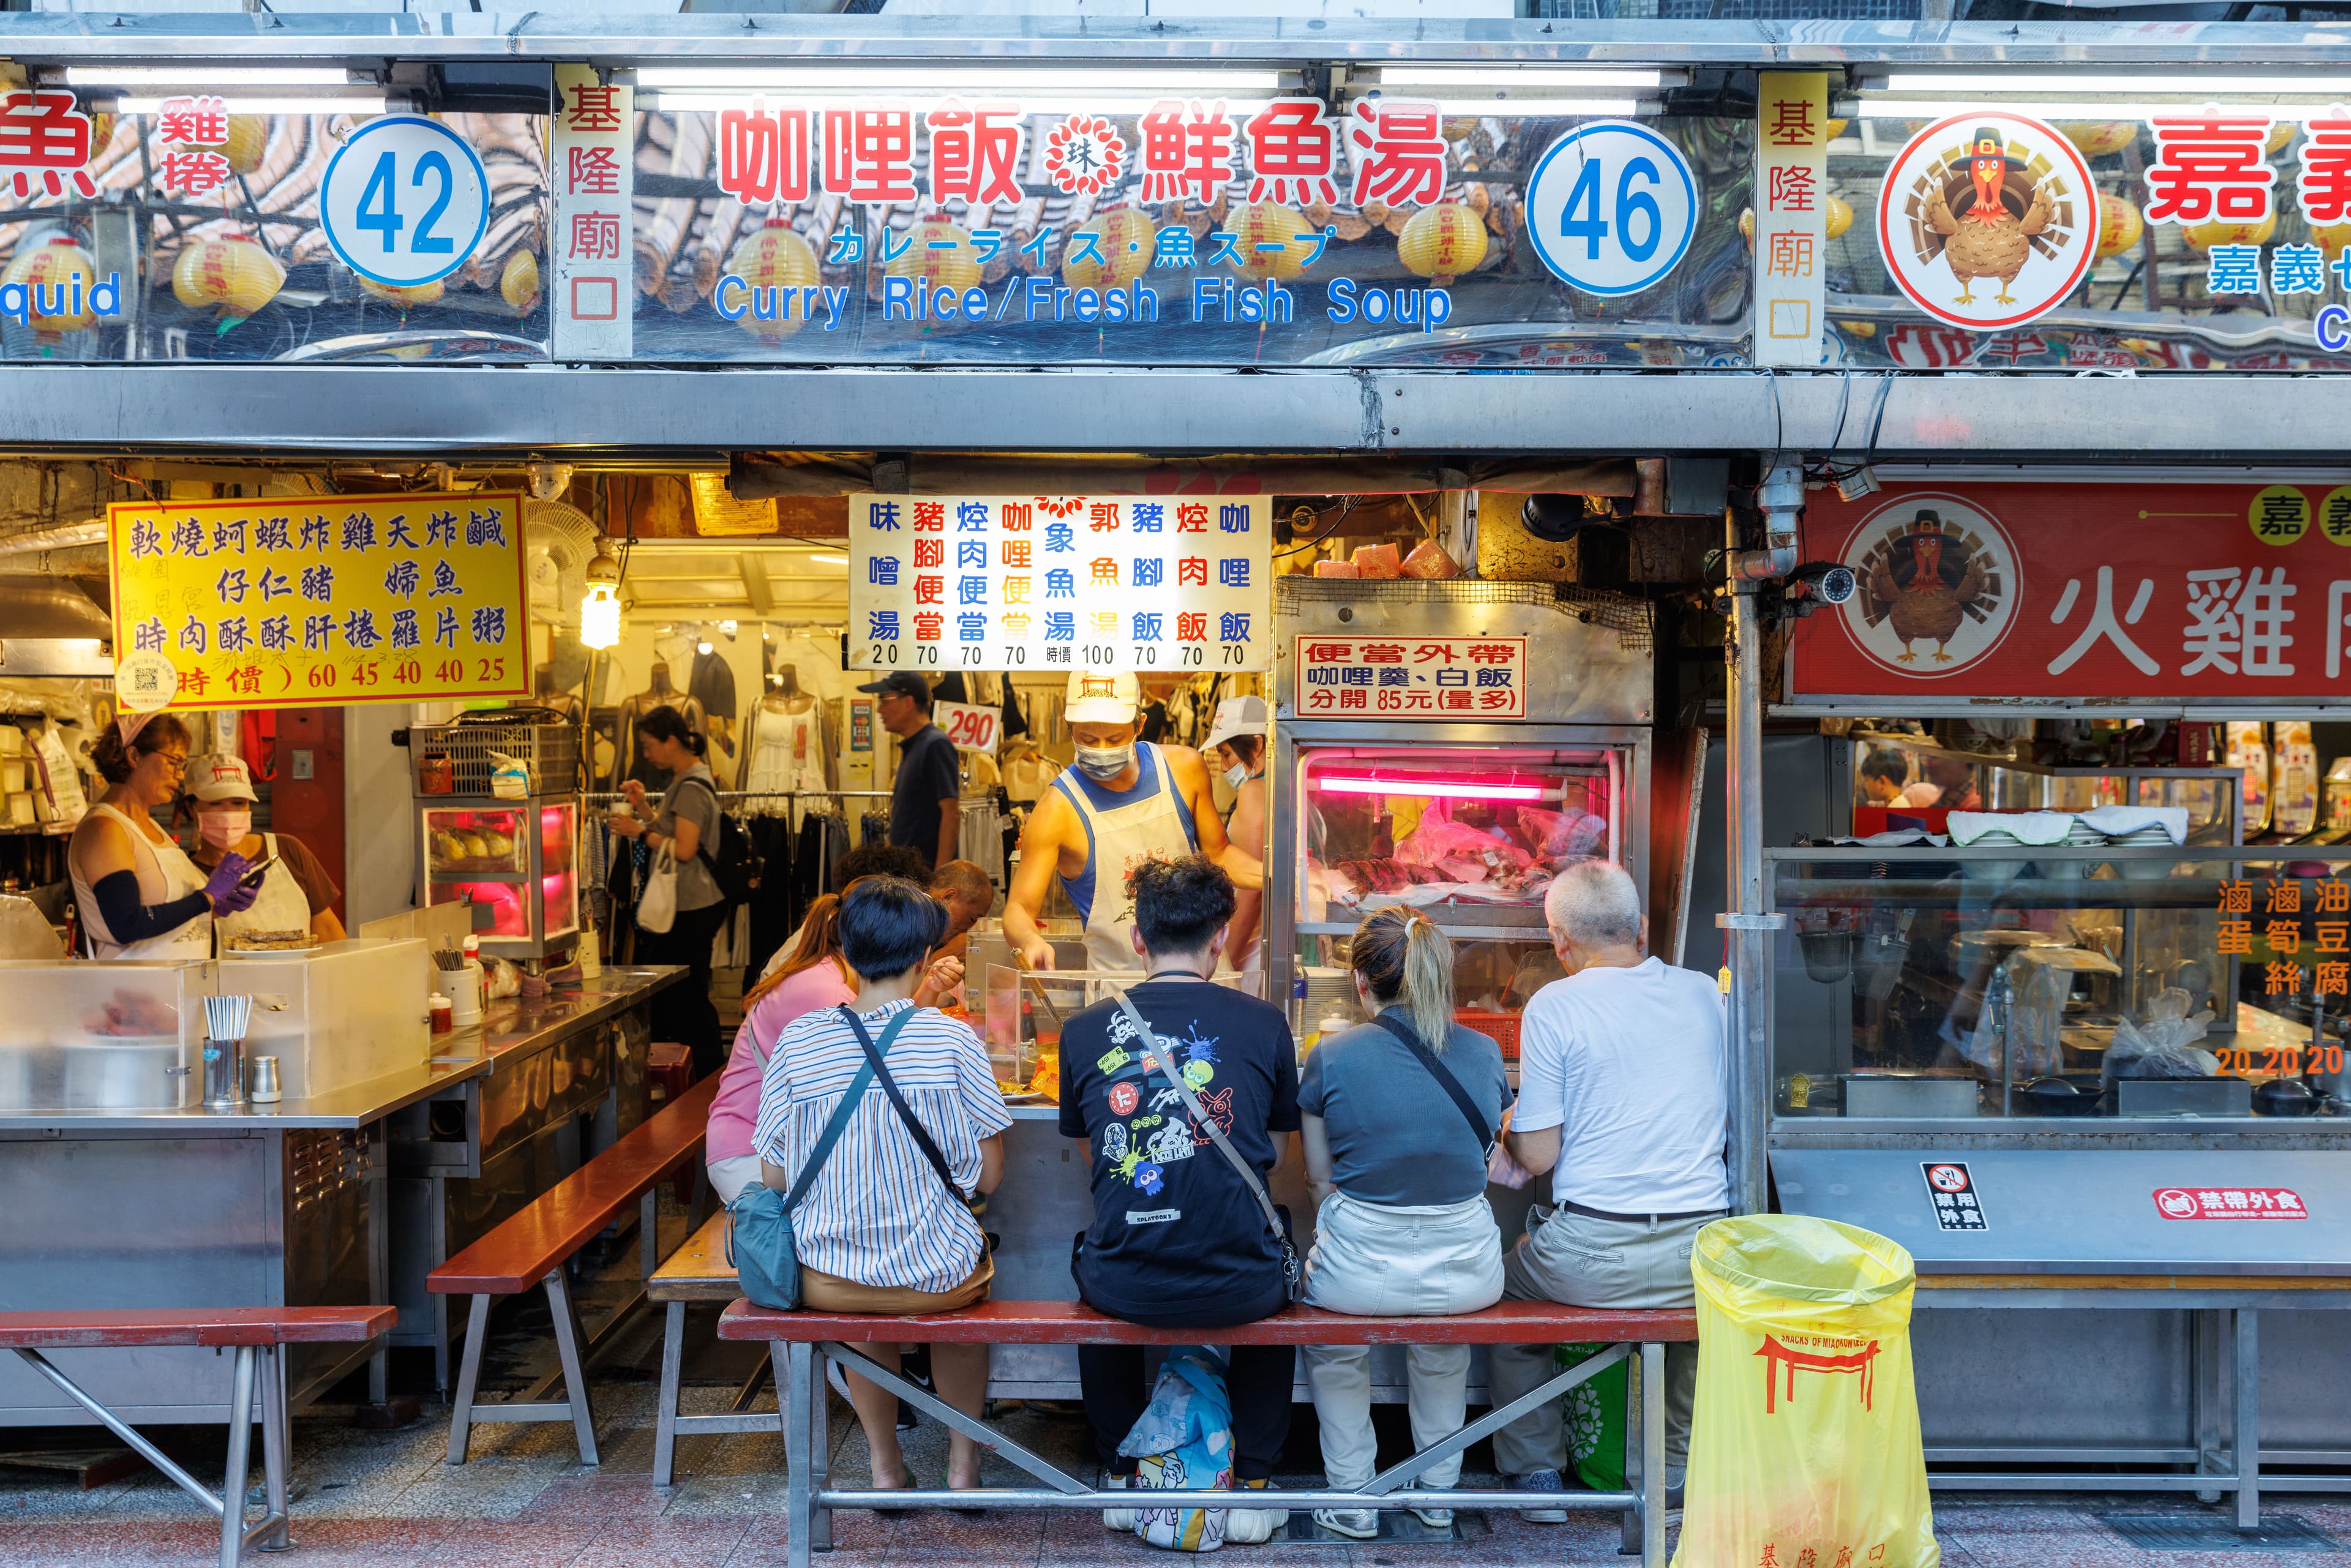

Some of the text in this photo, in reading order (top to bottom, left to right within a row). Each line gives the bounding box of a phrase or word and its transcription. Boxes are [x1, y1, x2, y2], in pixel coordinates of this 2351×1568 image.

[159, 96, 230, 196] 雞捲
[719, 99, 1024, 206] 咖哩飯
[1067, 138, 1101, 174] 珠
[1141, 98, 1449, 207] 鮮魚湯
[356, 151, 454, 253] 42
[568, 83, 621, 321] 基隆廟口
[1560, 156, 1662, 263] 46
[1766, 99, 1817, 339] 基隆廟口
[0, 272, 121, 326] quid
[715, 274, 849, 331] Curry
[1194, 276, 1293, 323] Fish
[1327, 277, 1452, 334] Soup
[213, 519, 253, 653] 蚵仔酥
[254, 517, 296, 651] 蝦仁酥
[299, 514, 337, 652] 炸豬肝
[384, 514, 421, 649] 天婦羅
[426, 511, 463, 650] 炸魚片
[868, 501, 901, 640] 味噌湯
[913, 501, 945, 641] 豬腳便當
[1001, 501, 1032, 641] 咖哩便當
[1044, 523, 1076, 642] 象魚湯
[1089, 502, 1120, 642] 郭魚湯
[1132, 503, 1164, 642] 豬腳飯
[1220, 503, 1251, 642] 咖哩飯
[2046, 565, 2351, 679] 火雞
[392, 661, 421, 685] 40
[435, 659, 463, 683] 40
[477, 656, 504, 681] 25
[916, 645, 938, 665] 70
[961, 646, 981, 666] 70
[1005, 645, 1026, 666] 70
[1046, 646, 1071, 663] 時價
[1082, 643, 1114, 665] 100
[1134, 646, 1156, 666] 70
[1182, 647, 1203, 666] 70
[1222, 645, 1244, 665] 70
[1304, 643, 1516, 664] 便當外帶
[308, 663, 336, 688] 60
[351, 662, 378, 686] 45
[1307, 666, 1513, 688] 咖哩羹、白飯
[1308, 689, 1367, 709] 分開
[947, 709, 994, 748] 290
[2216, 879, 2253, 955] 滷蛋
[2265, 878, 2302, 996] 滷筍絲
[2313, 878, 2350, 996] 油豆腐
[2214, 1048, 2252, 1076] 20
[2262, 1046, 2299, 1075] 20
[2306, 1045, 2344, 1075] 20
[1136, 1214, 1168, 1223] SPLATOON
[1934, 1193, 1976, 1207] 禁用
[1940, 1209, 1982, 1223] 外食
[2197, 1191, 2301, 1210] 禁帶外食
[1812, 1337, 1821, 1347] OF
